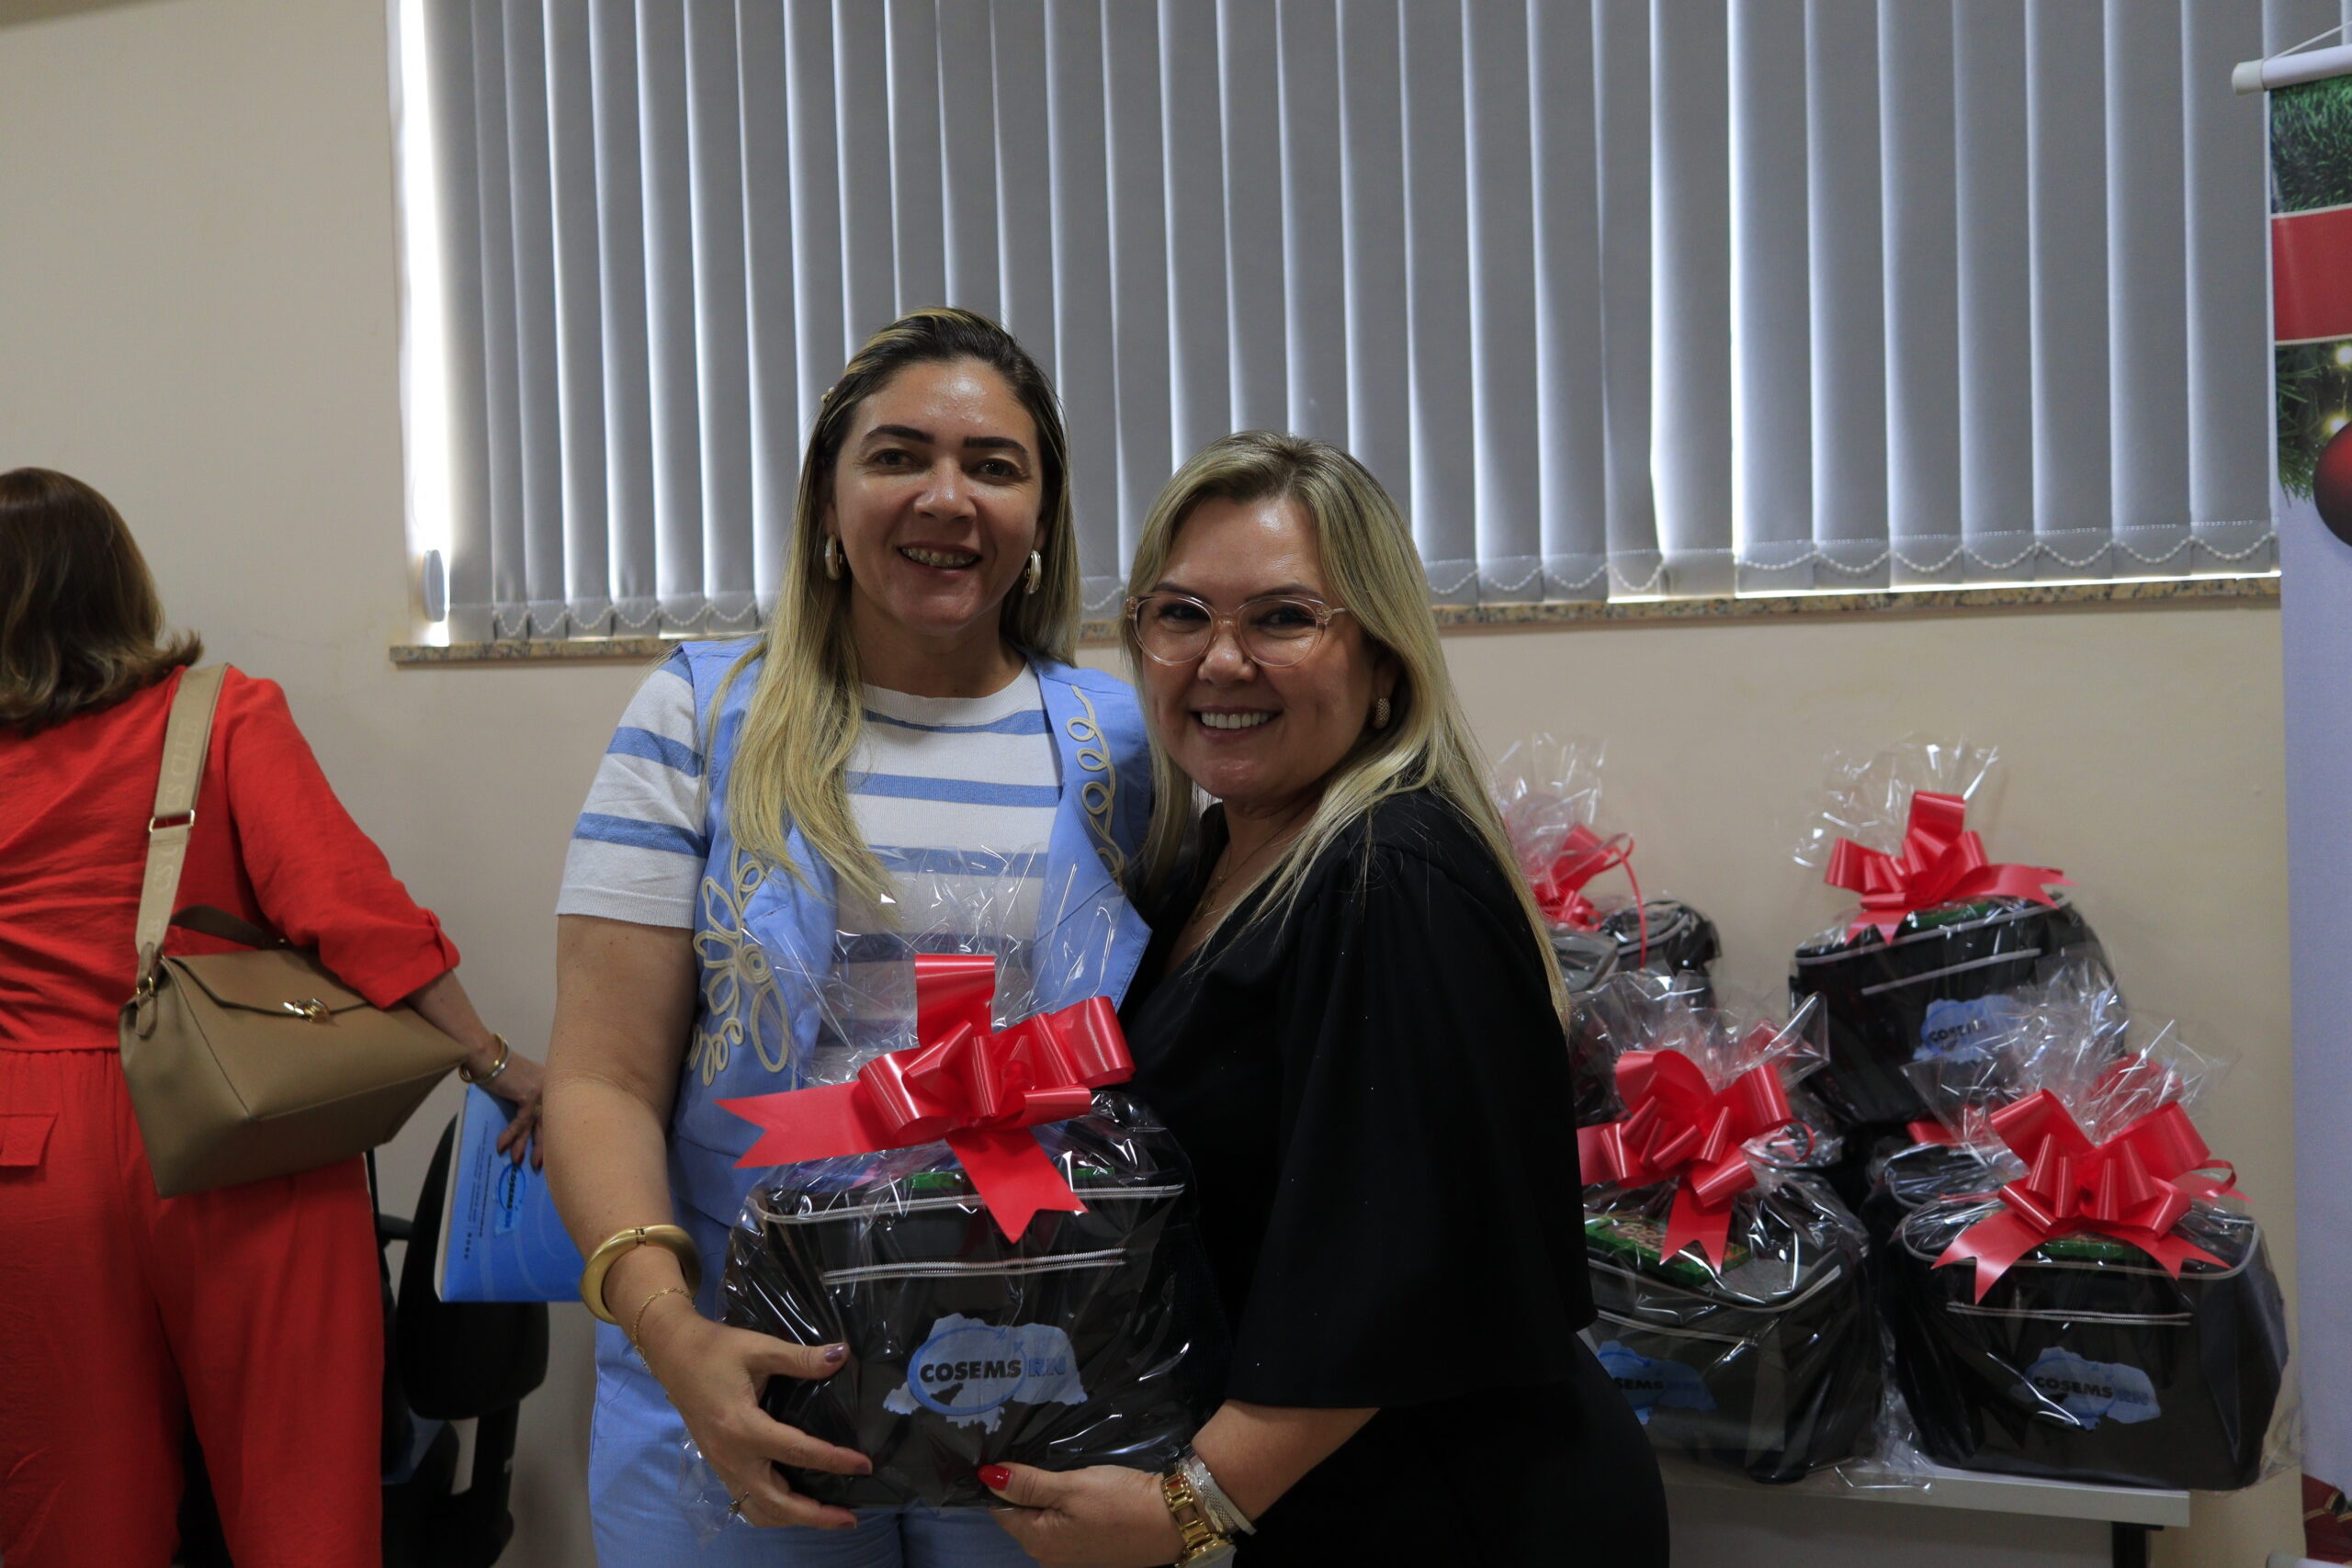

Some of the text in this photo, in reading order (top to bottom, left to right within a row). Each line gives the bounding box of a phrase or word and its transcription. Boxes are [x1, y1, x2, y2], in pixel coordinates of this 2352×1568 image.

[920, 1356, 1066, 1383] COSEMS RN
[1614, 1377, 1664, 1390] SEMS
[2033, 1376, 2113, 1399] COSEMS
